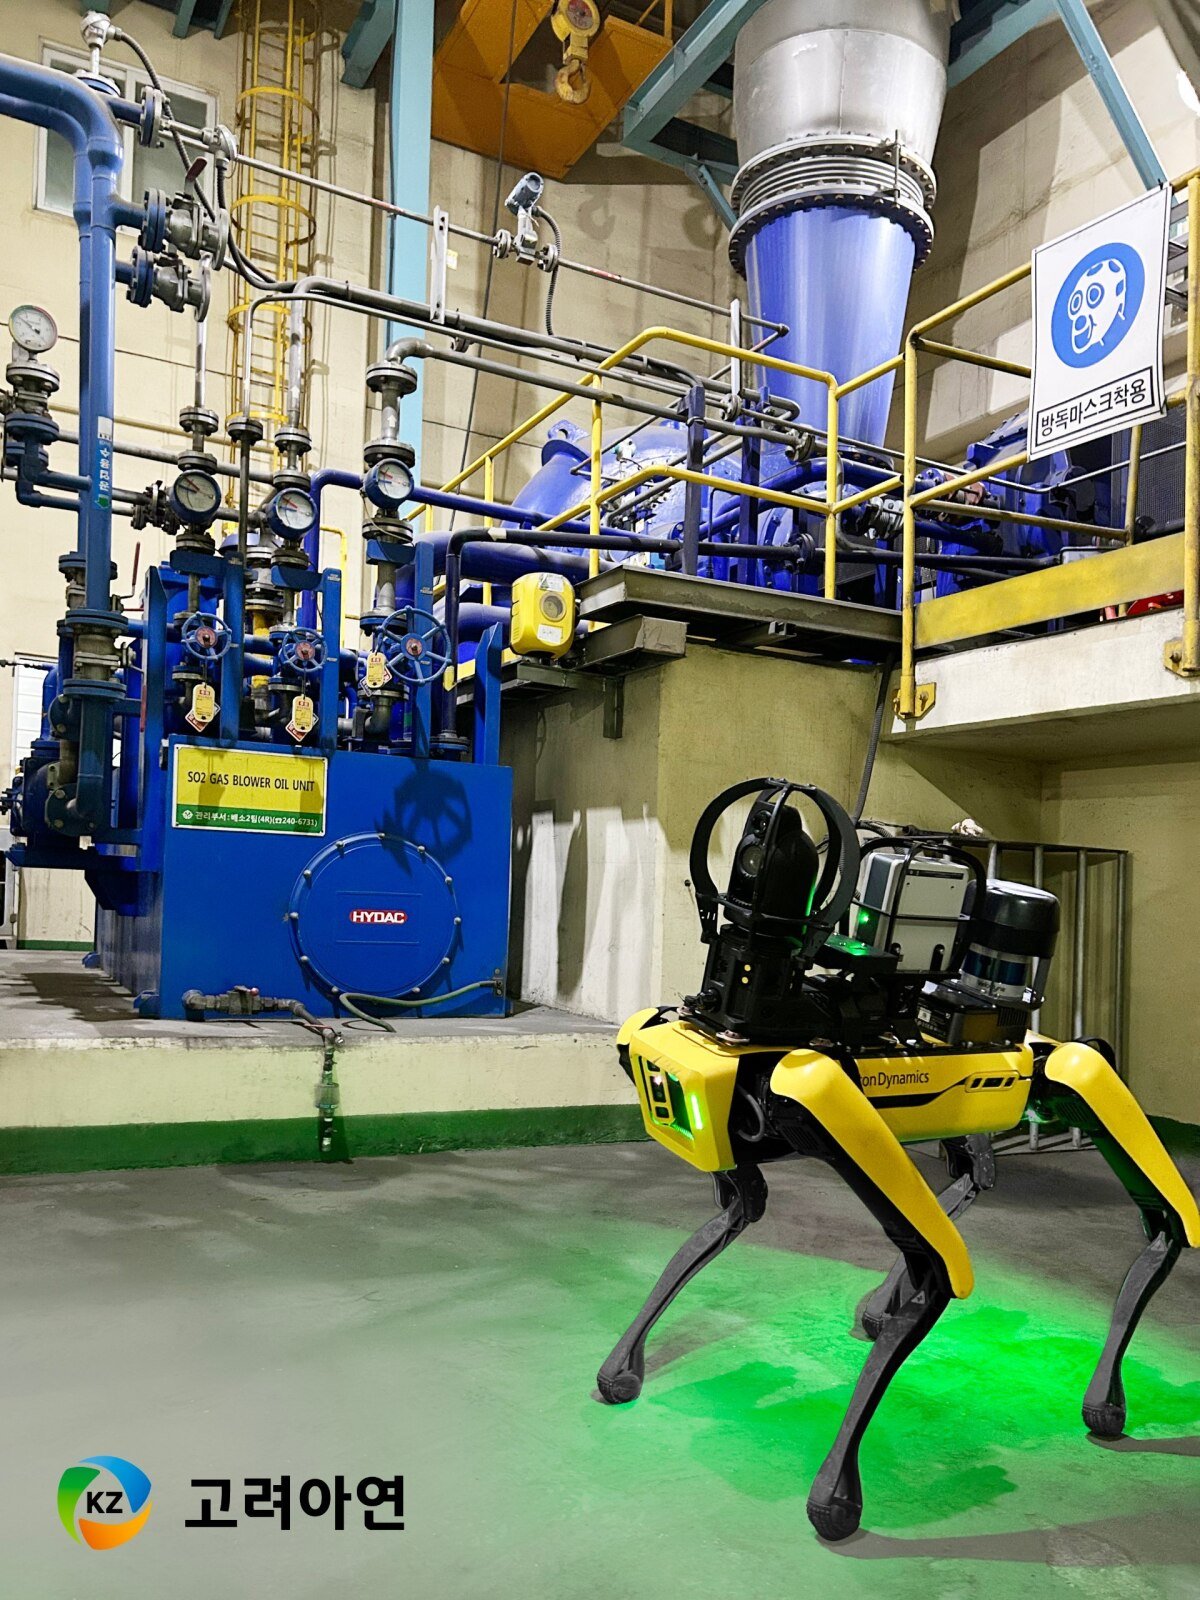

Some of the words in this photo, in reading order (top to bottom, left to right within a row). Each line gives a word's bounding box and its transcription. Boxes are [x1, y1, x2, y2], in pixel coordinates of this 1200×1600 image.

[1041, 378, 1146, 437] 방독마스크착용
[187, 771, 206, 784] SO2
[209, 772, 229, 786] GAS
[232, 774, 271, 789] BLOWER
[274, 778, 289, 790] OIL
[292, 779, 315, 792] UNIT
[352, 910, 405, 924] HYDAC
